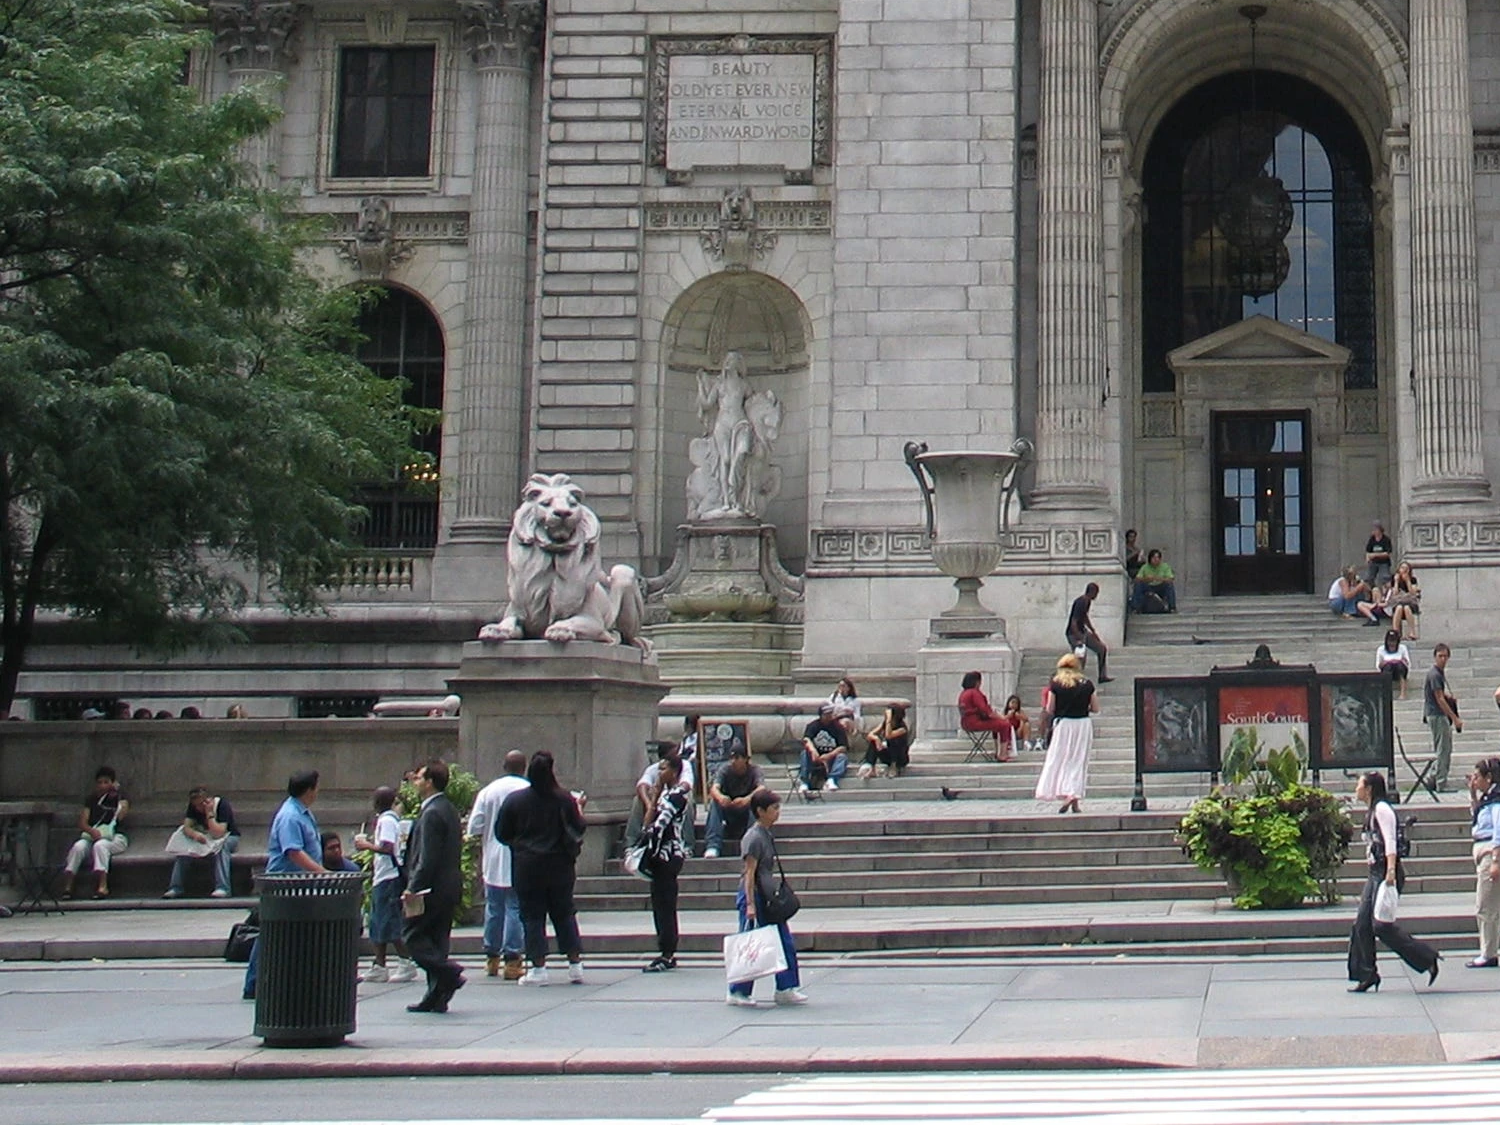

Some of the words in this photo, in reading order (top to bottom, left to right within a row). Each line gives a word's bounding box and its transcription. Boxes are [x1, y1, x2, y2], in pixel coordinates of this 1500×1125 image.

[712, 62, 773, 76] BEAUTY
[670, 83, 701, 98] OLD
[705, 83, 733, 98] YET
[735, 82, 773, 97] EVER
[776, 82, 812, 96] NEW
[679, 104, 750, 119] ETERNAL
[755, 104, 802, 118] VOICE
[669, 126, 700, 140] AND
[702, 126, 765, 140] INWARD
[766, 126, 811, 139] WORD
